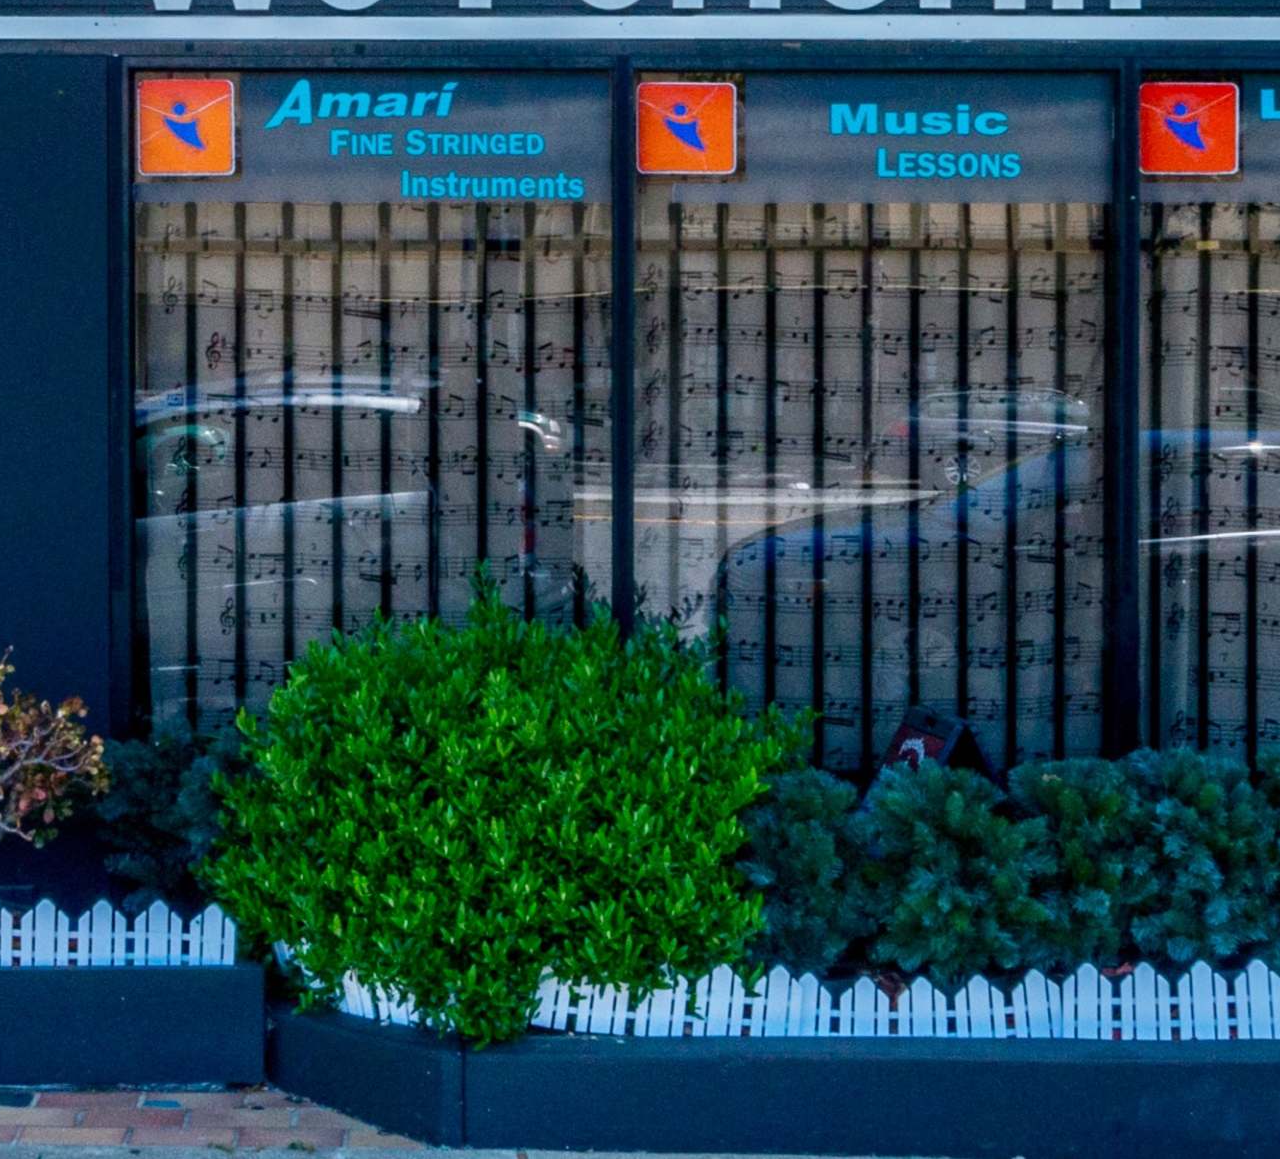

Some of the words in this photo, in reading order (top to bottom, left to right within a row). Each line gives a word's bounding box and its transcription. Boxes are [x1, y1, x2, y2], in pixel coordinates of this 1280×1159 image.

[829, 103, 1009, 136] Music
[329, 128, 394, 156] FINE
[405, 128, 545, 156] STRINGED
[876, 147, 1021, 178] LESSONS
[400, 169, 585, 200] Instruments
